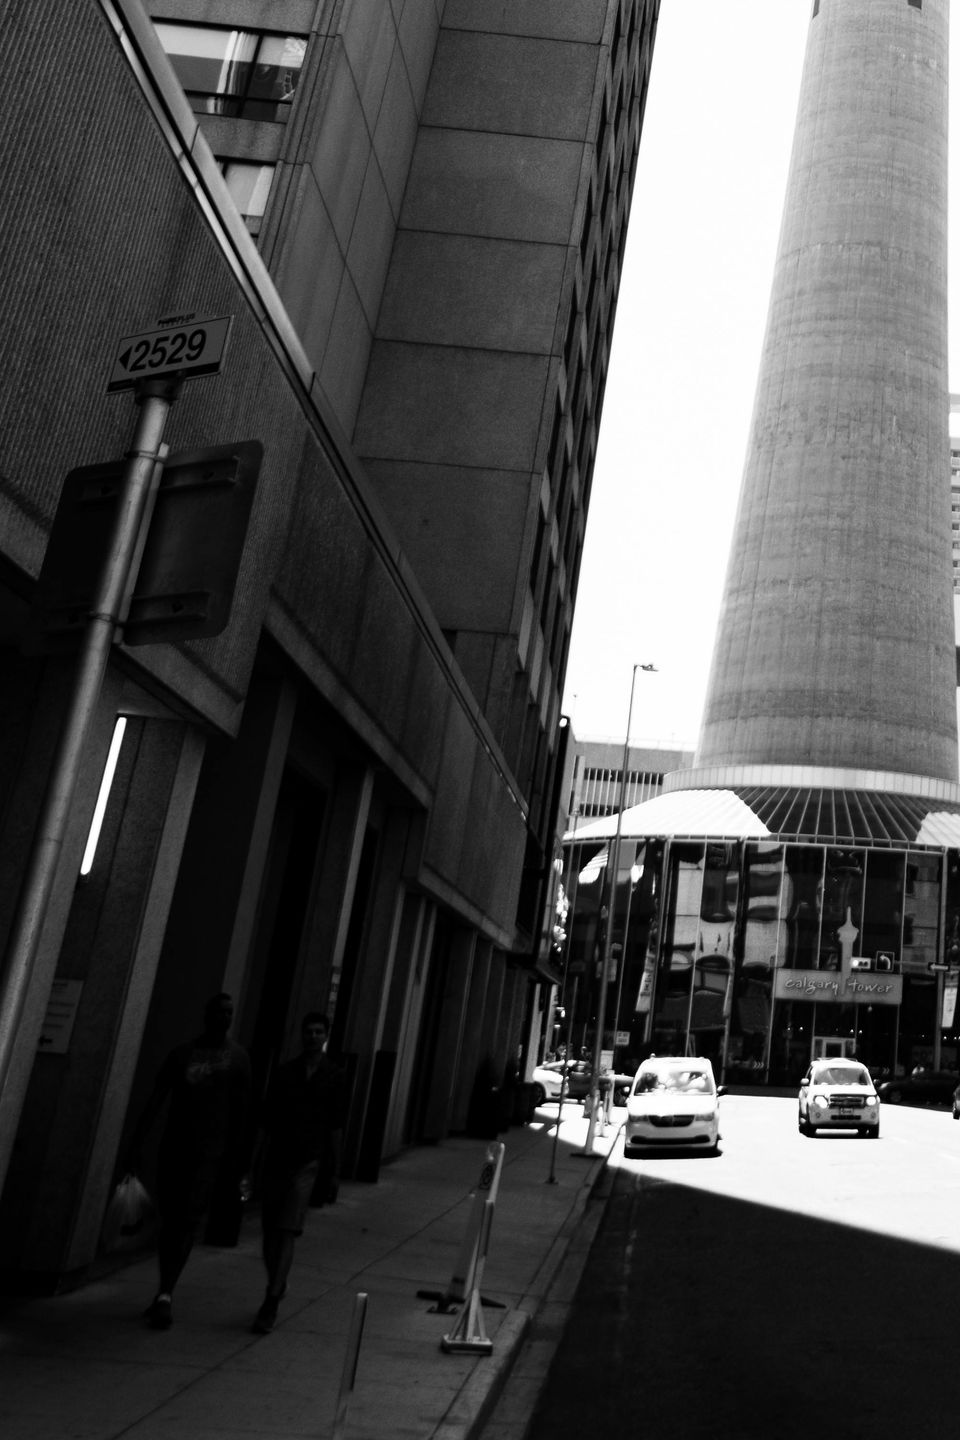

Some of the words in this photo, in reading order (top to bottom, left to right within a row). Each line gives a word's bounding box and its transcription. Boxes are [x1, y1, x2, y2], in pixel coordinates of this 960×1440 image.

[129, 328, 207, 372] 2529
[784, 975, 839, 996] calgary
[848, 978, 893, 994] tower
